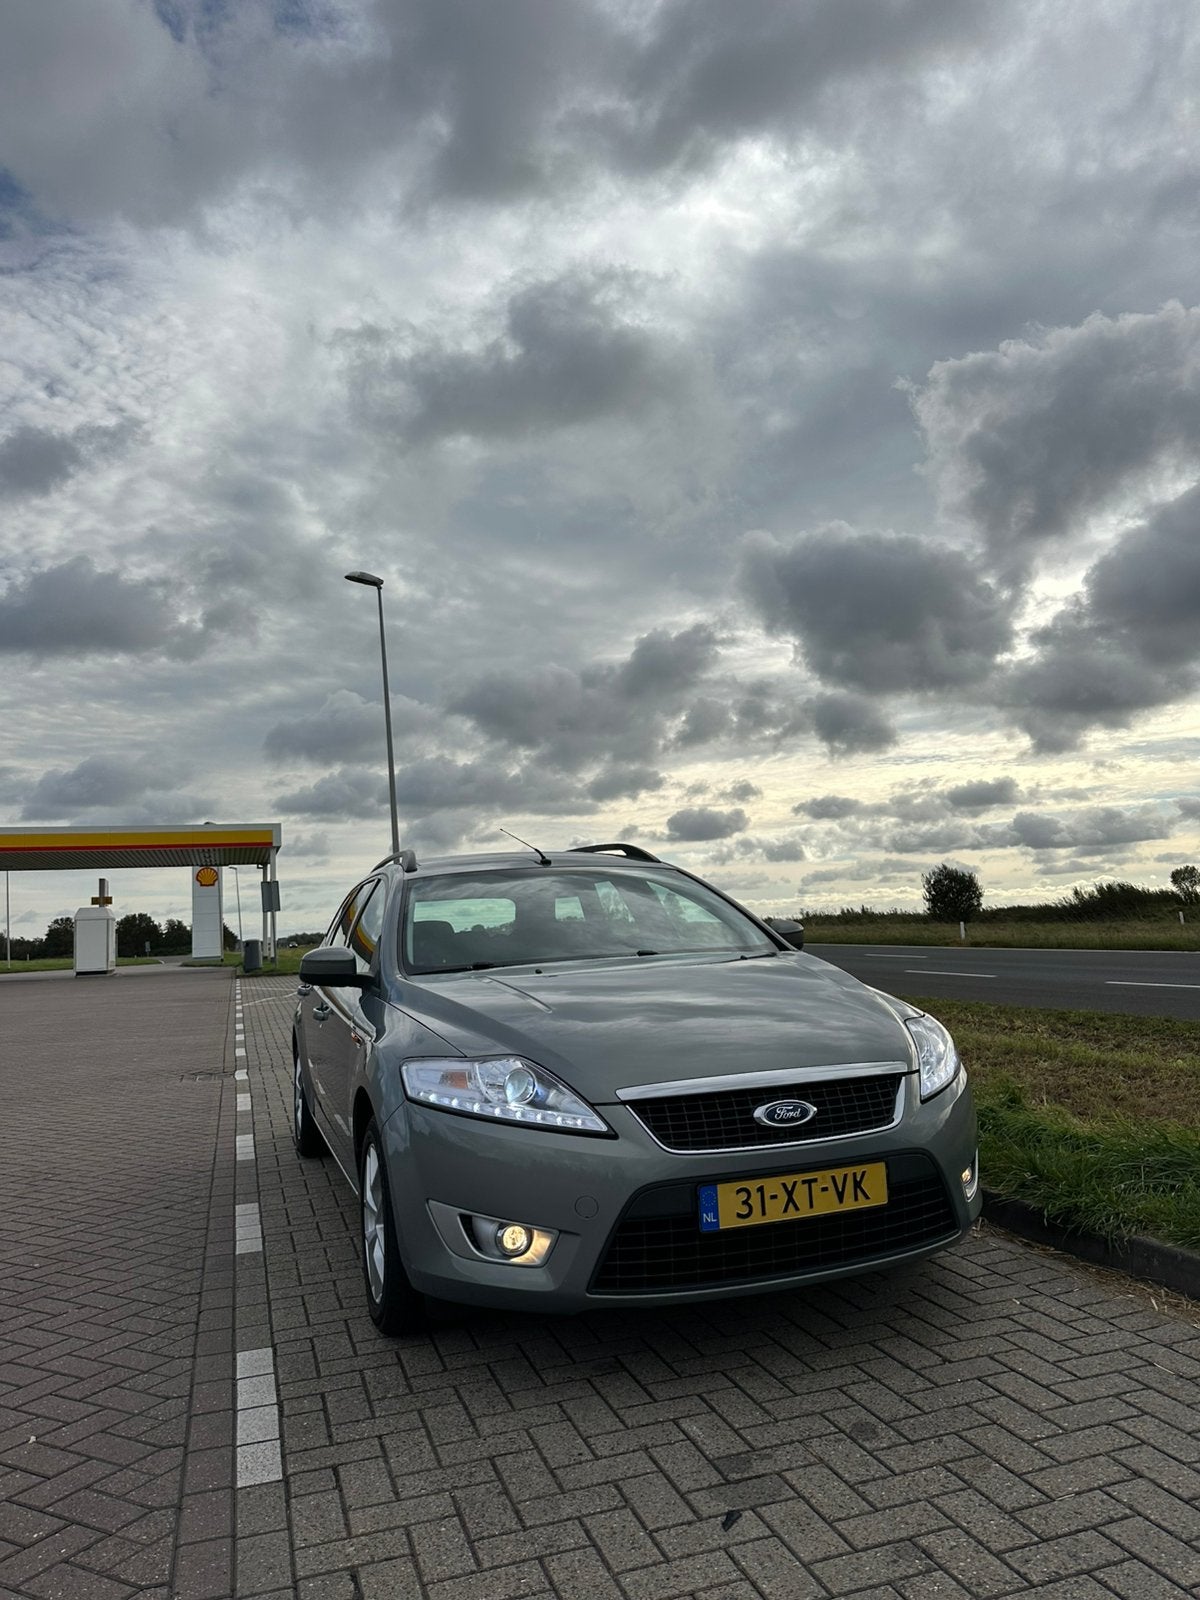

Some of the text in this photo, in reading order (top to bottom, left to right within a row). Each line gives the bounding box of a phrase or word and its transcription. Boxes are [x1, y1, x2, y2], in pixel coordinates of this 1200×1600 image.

[774, 1105, 801, 1120] Ford
[735, 1170, 871, 1220] 31-XT-VK
[702, 1212, 717, 1223] NL
